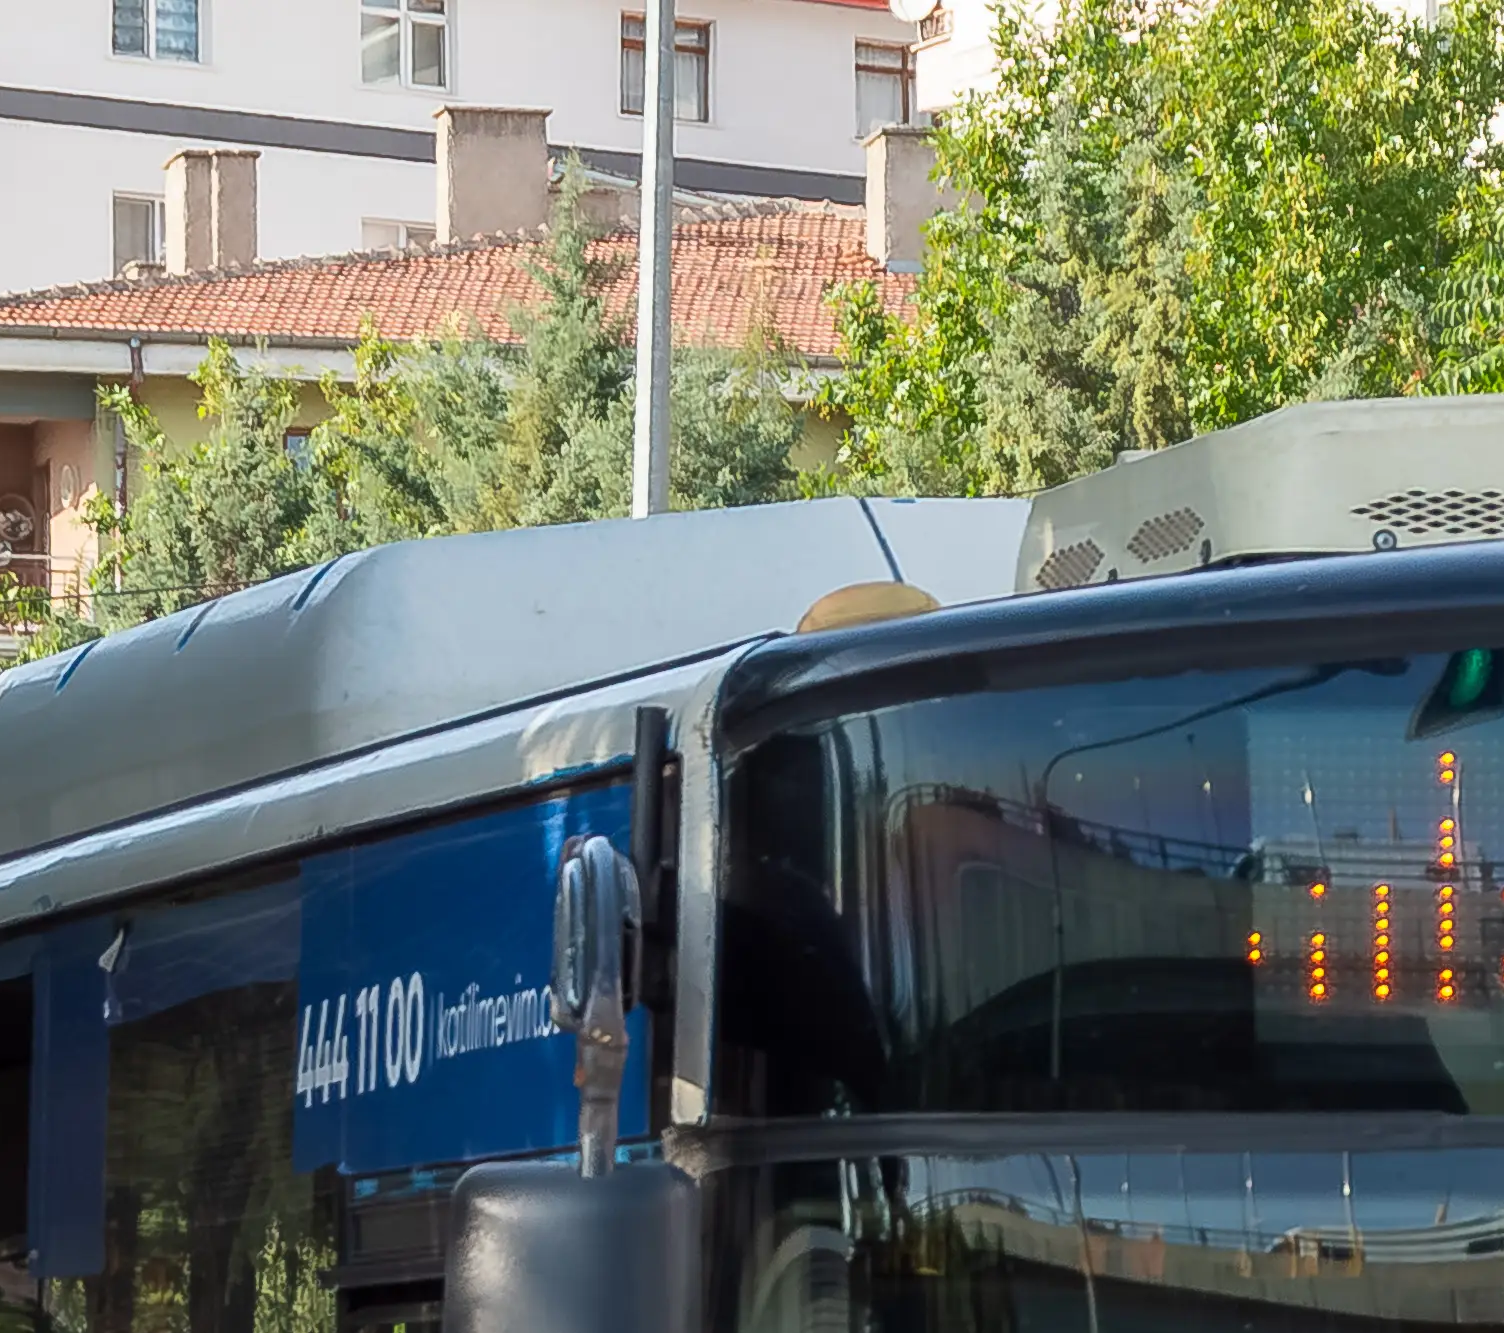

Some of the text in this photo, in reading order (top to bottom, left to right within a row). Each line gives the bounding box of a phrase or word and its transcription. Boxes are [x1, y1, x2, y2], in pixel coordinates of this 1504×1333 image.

[296, 992, 349, 1108] 444
[355, 983, 380, 1095] 11
[385, 970, 424, 1088] 00
